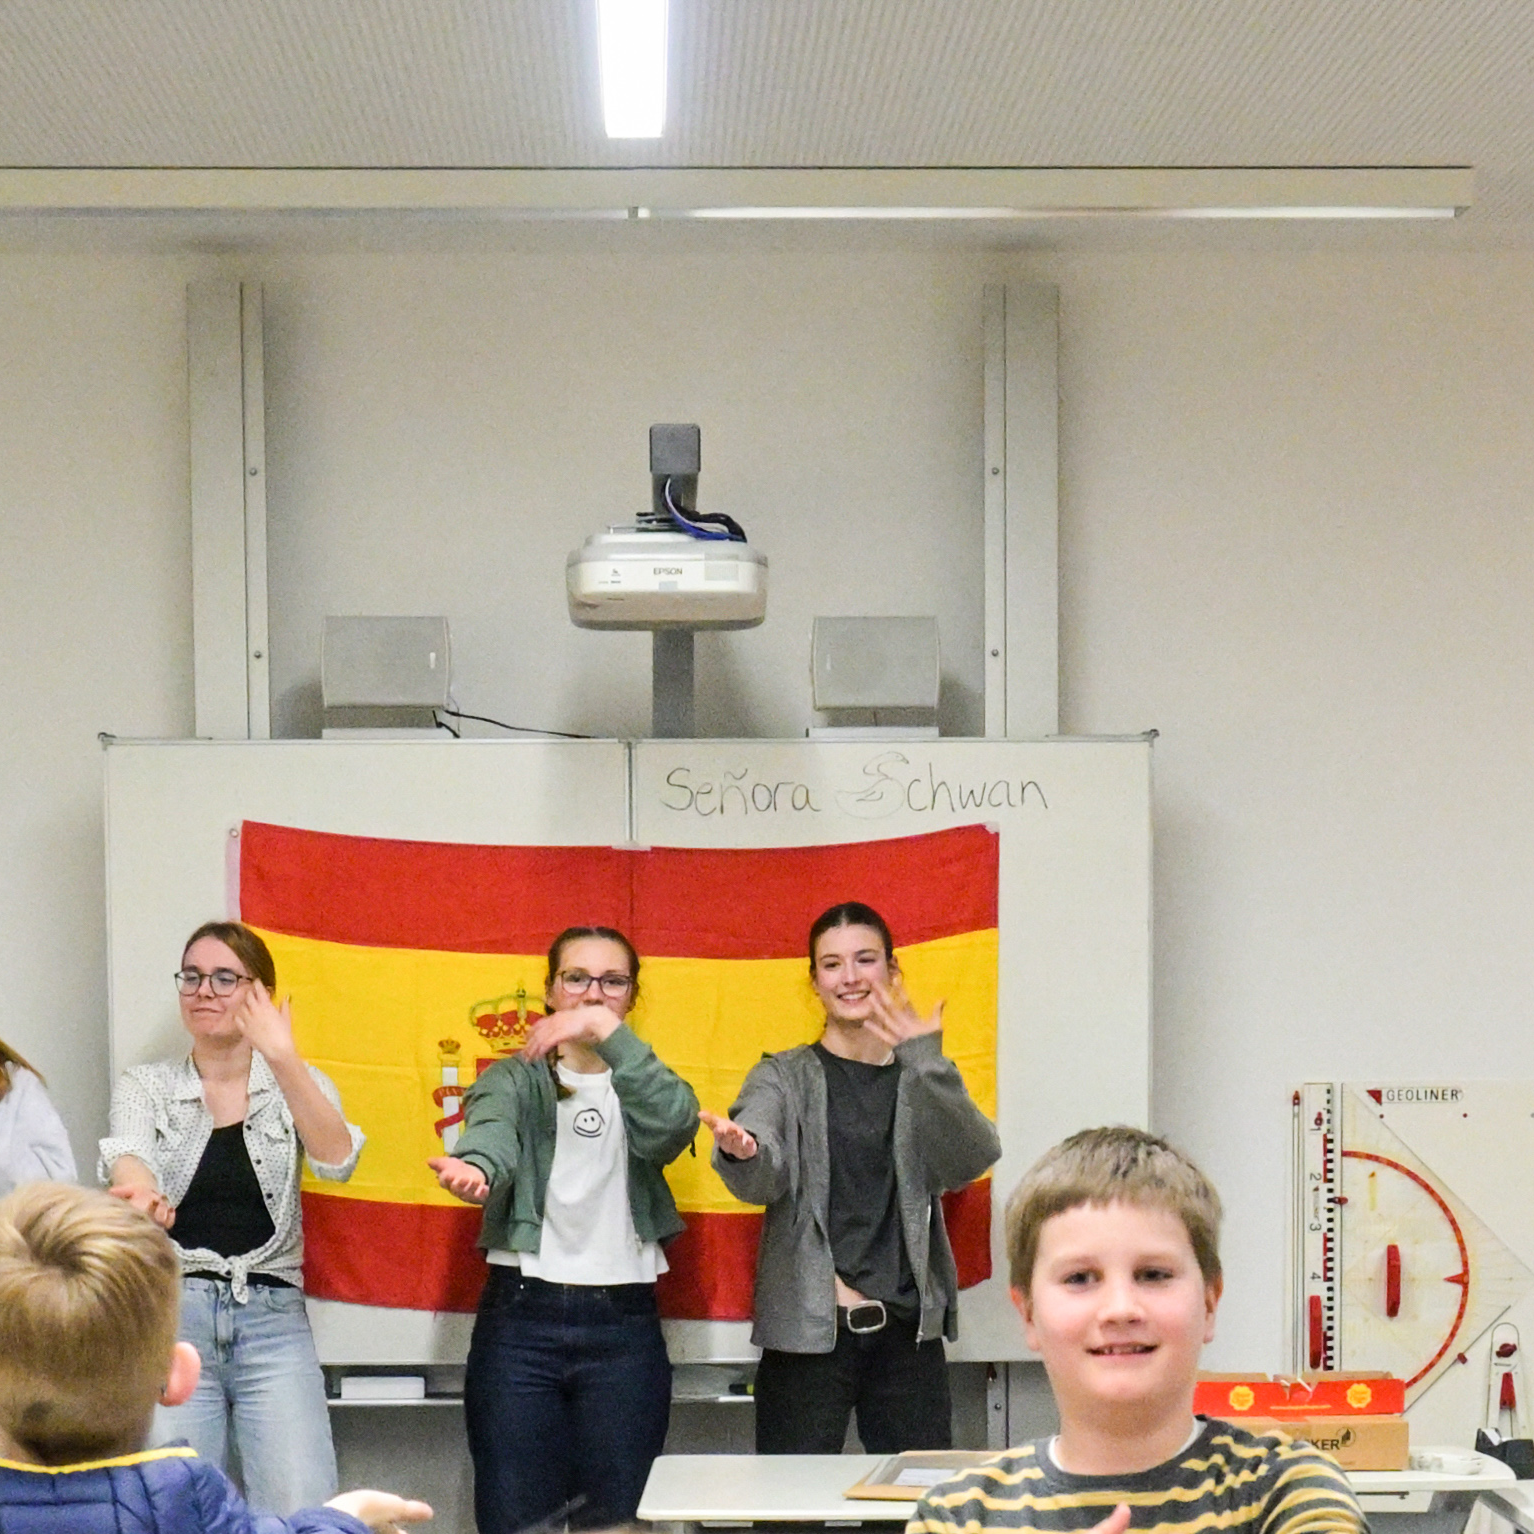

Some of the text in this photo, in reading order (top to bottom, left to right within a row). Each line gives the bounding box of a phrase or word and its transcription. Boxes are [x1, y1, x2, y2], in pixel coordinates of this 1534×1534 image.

[653, 567, 683, 575] EPSON
[660, 767, 821, 816] Señora
[1386, 1089, 1459, 1101] GEOLINER
[1305, 1438, 1341, 1451] KER
